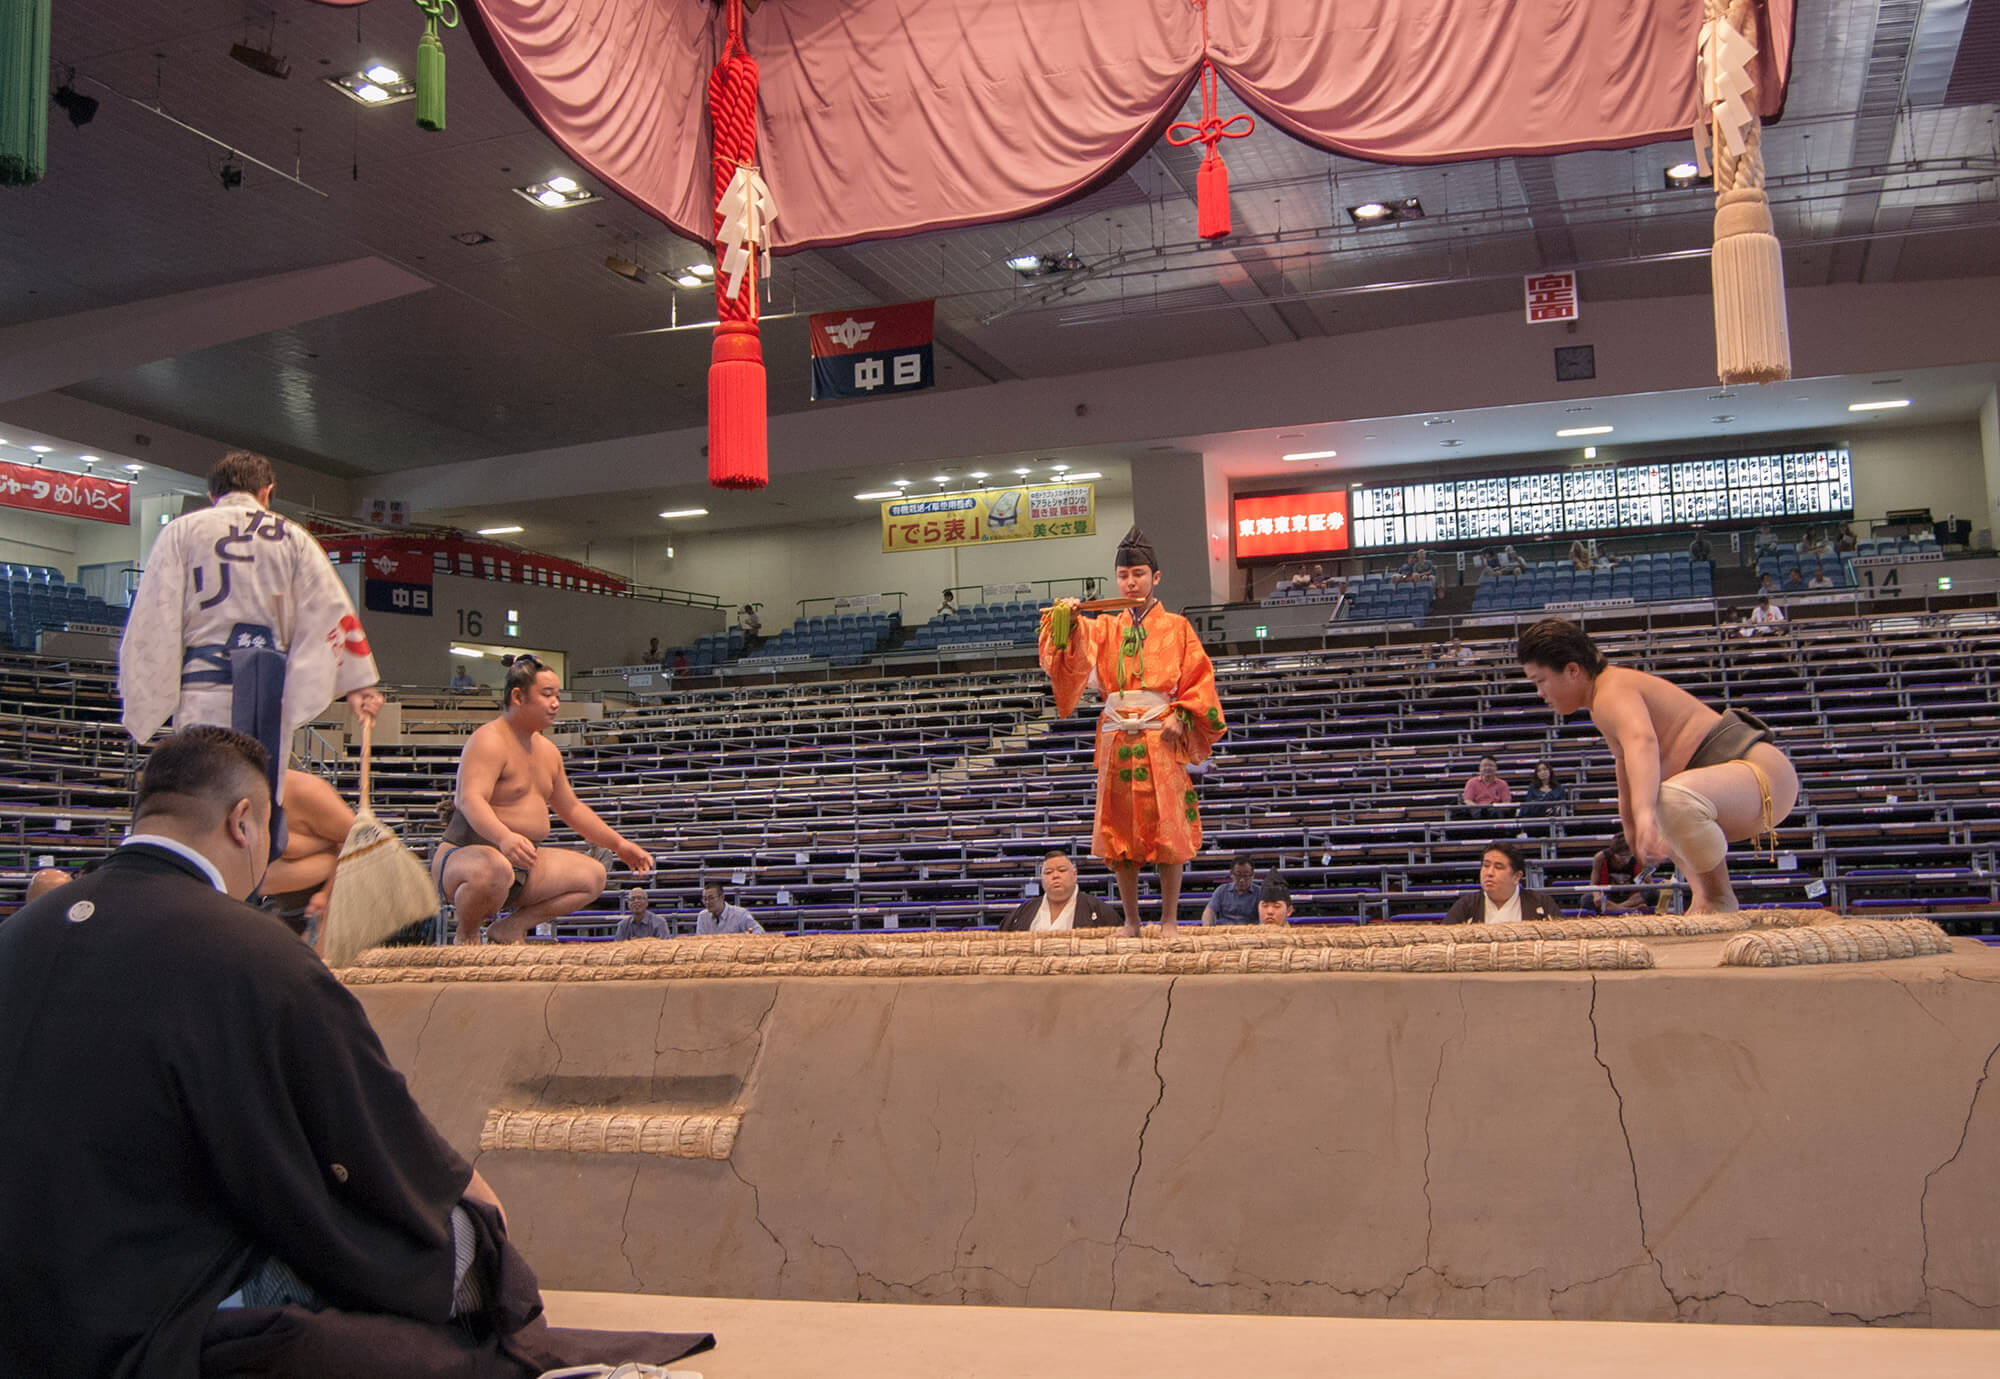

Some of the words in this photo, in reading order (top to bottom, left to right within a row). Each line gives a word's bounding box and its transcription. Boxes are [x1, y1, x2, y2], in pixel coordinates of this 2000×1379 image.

[1528, 274, 1574, 320] 向正面
[855, 354, 921, 390] 中日
[54, 484, 122, 513] めいらく
[1033, 521, 1087, 537] 美ぐさ畳
[1239, 511, 1344, 537] 東海東京証券
[193, 510, 291, 610] なとり
[1864, 568, 1902, 599] 14
[392, 588, 428, 608] 中日
[458, 609, 483, 637] 16
[1195, 615, 1227, 642] 15
